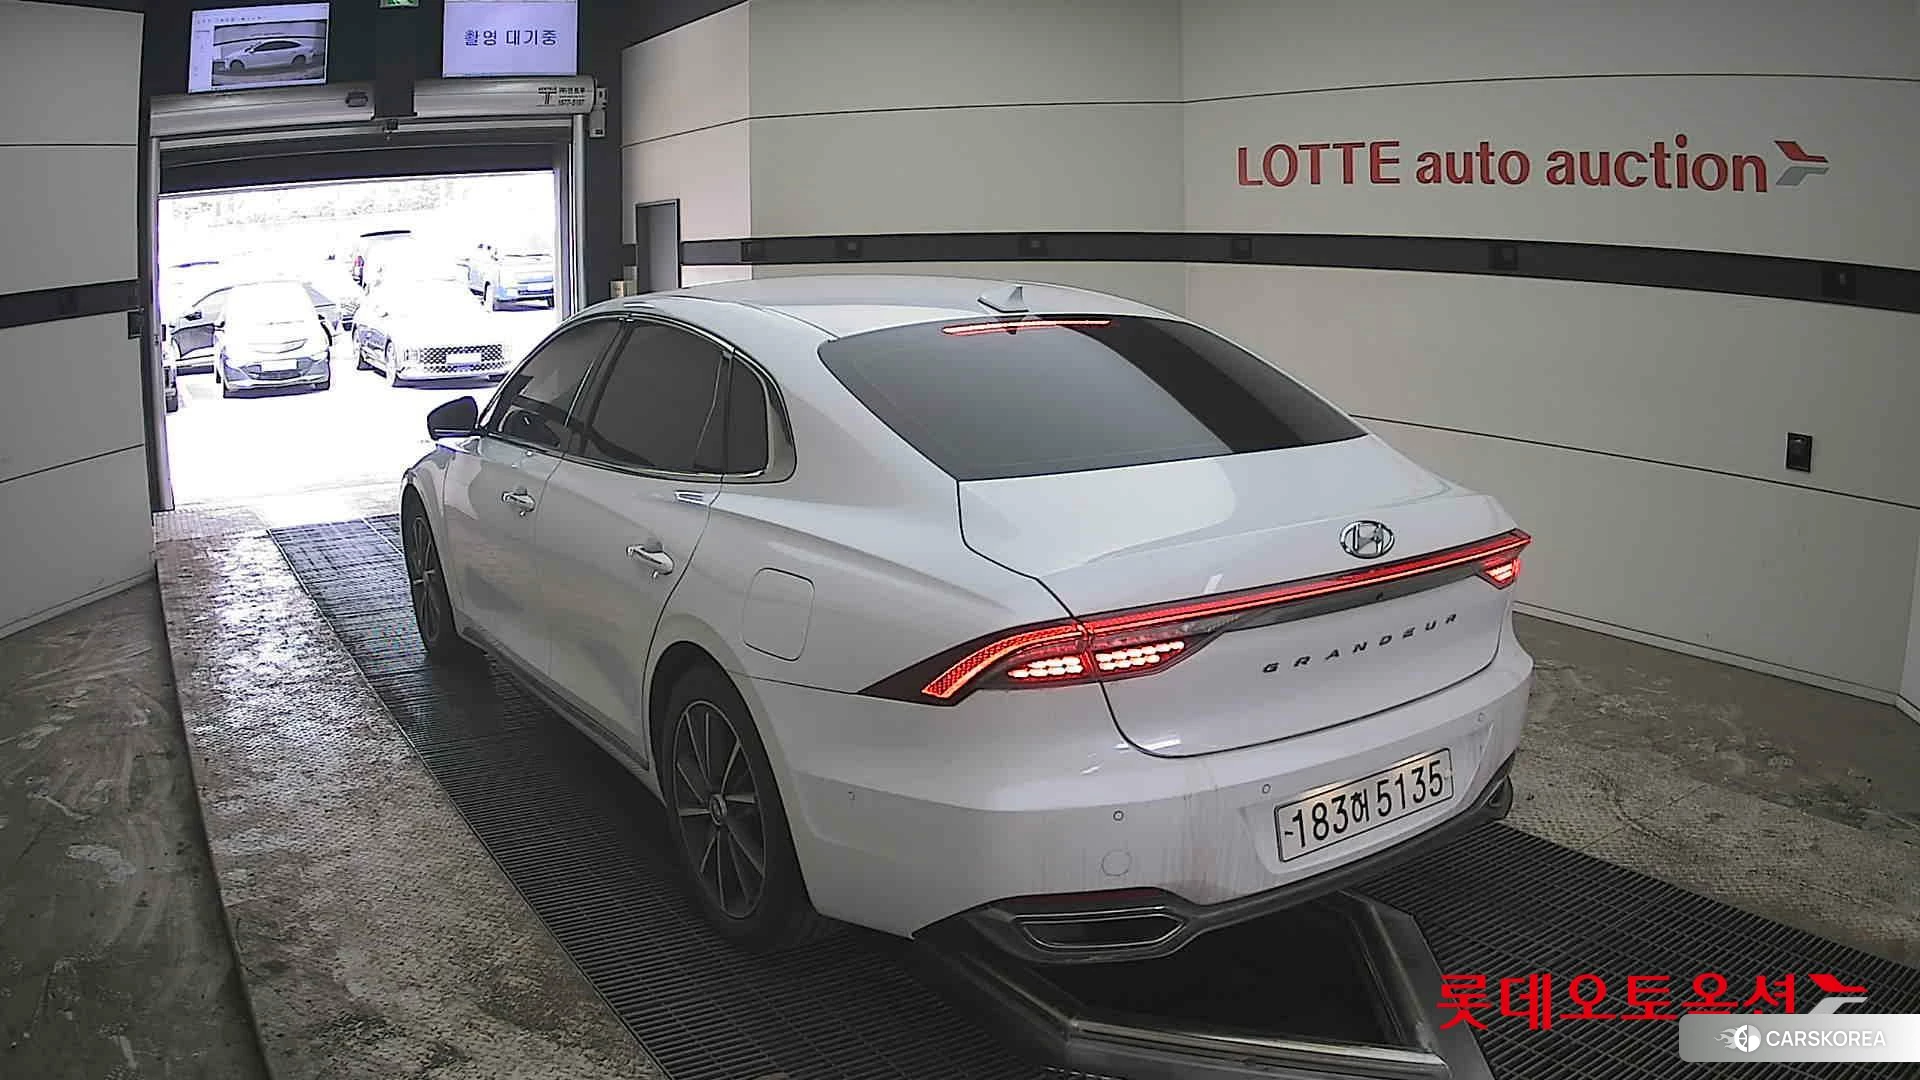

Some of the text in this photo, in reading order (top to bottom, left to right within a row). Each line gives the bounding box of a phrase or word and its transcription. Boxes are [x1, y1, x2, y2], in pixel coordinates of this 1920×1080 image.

[505, 29, 557, 46] 대기중
[1237, 134, 1768, 193] LOTTE auto auction
[1262, 613, 1457, 673] GRANDEUR
[1376, 759, 1444, 817] 5135
